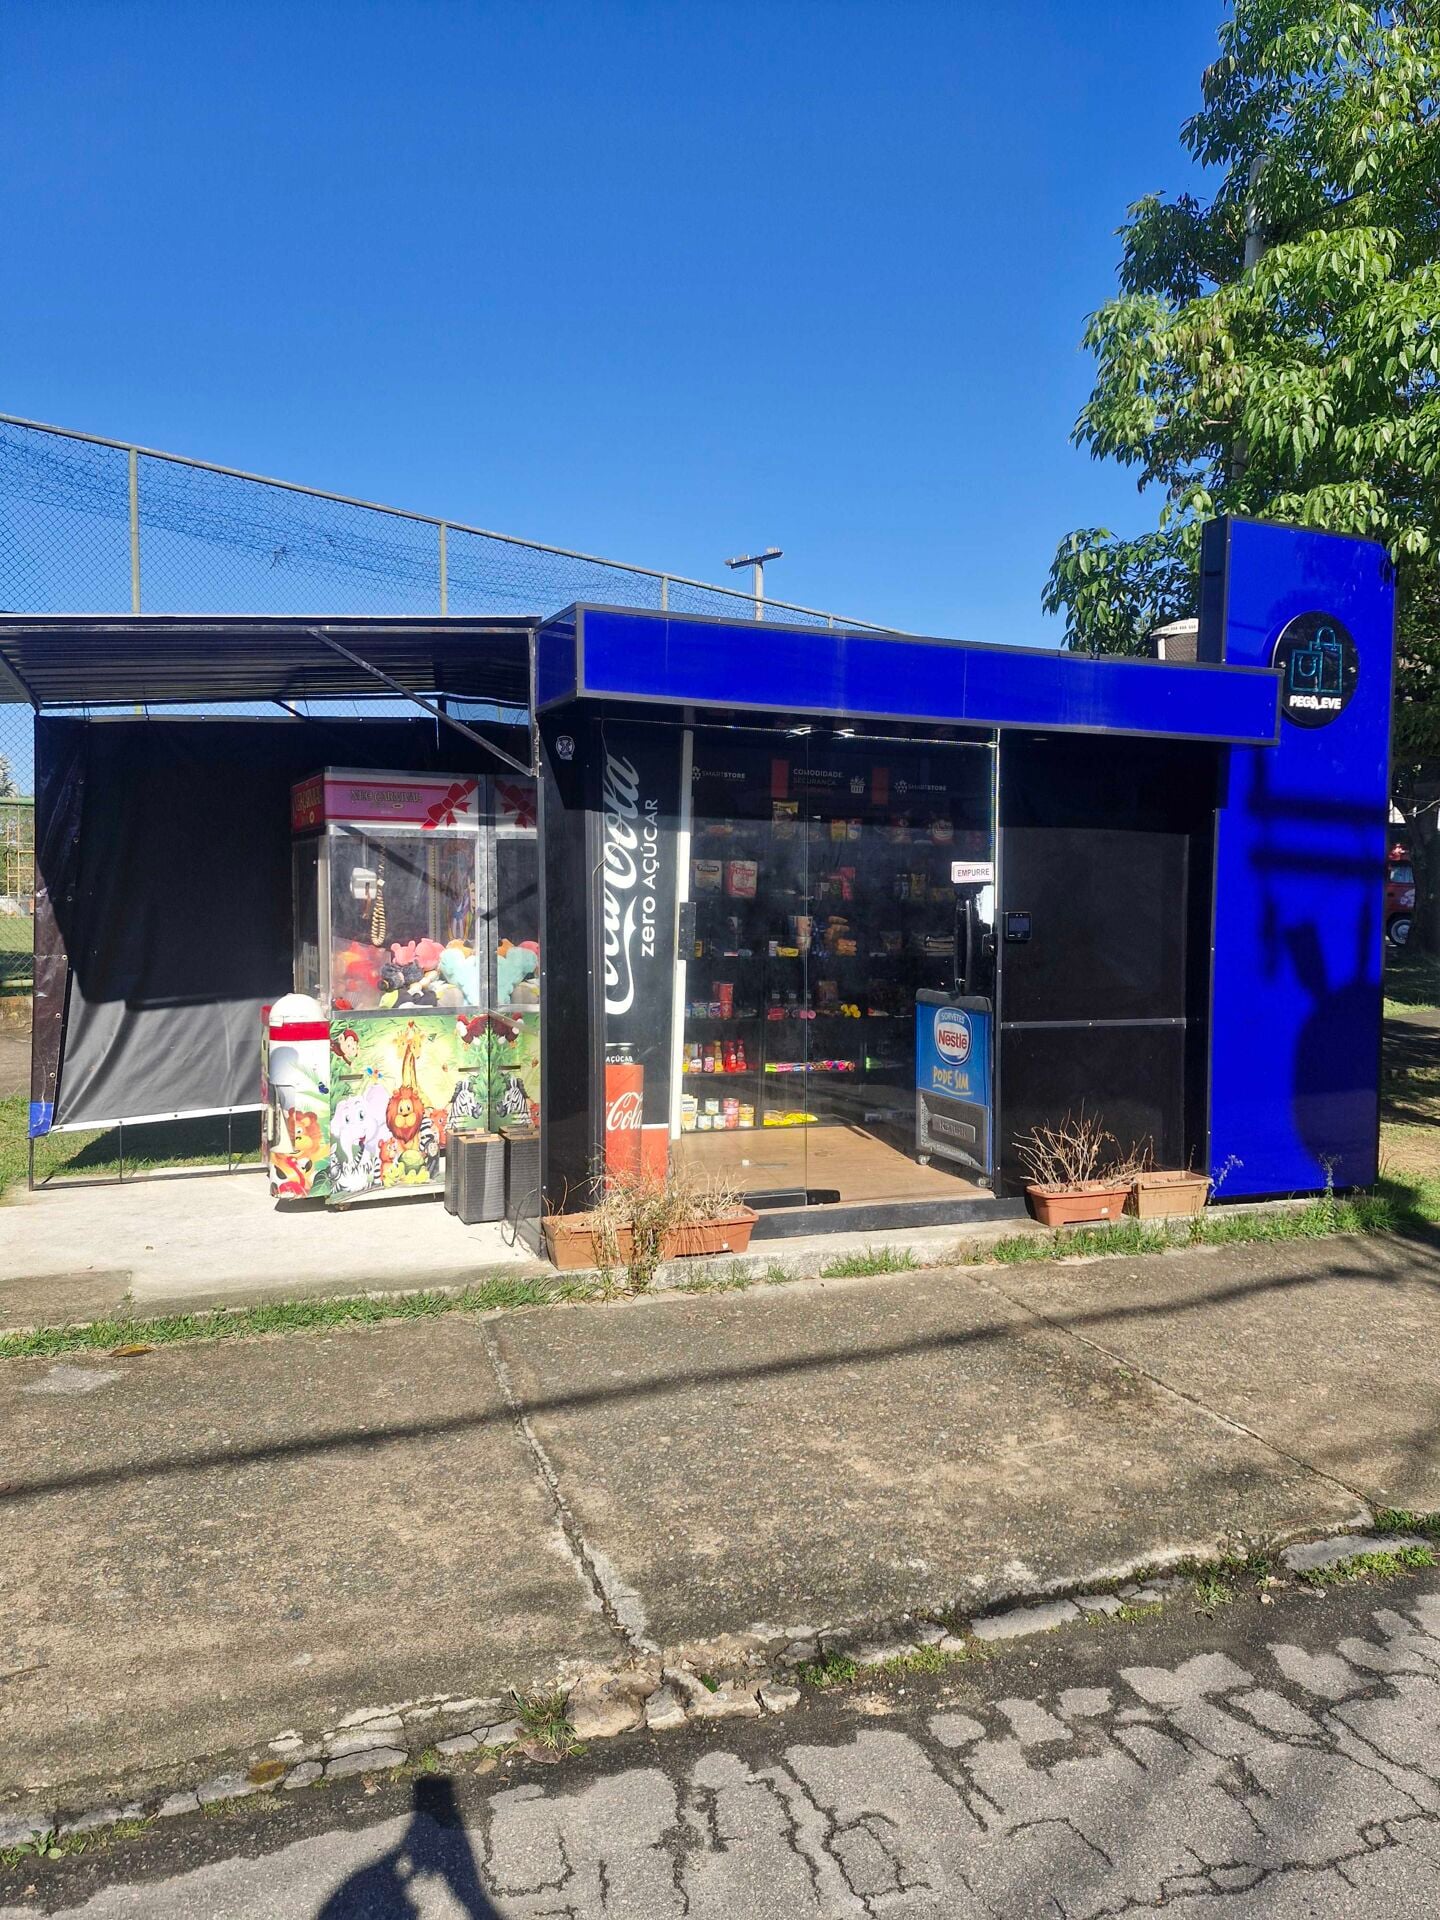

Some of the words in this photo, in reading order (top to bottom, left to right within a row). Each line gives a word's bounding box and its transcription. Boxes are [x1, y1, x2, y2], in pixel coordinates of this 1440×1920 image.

[640, 798, 660, 890] AÇÚCAR
[957, 868, 990, 877] EMPURRE
[641, 893, 656, 958] zero
[605, 1055, 633, 1064] AÇÚCAR
[954, 1069, 969, 1091] SIM
